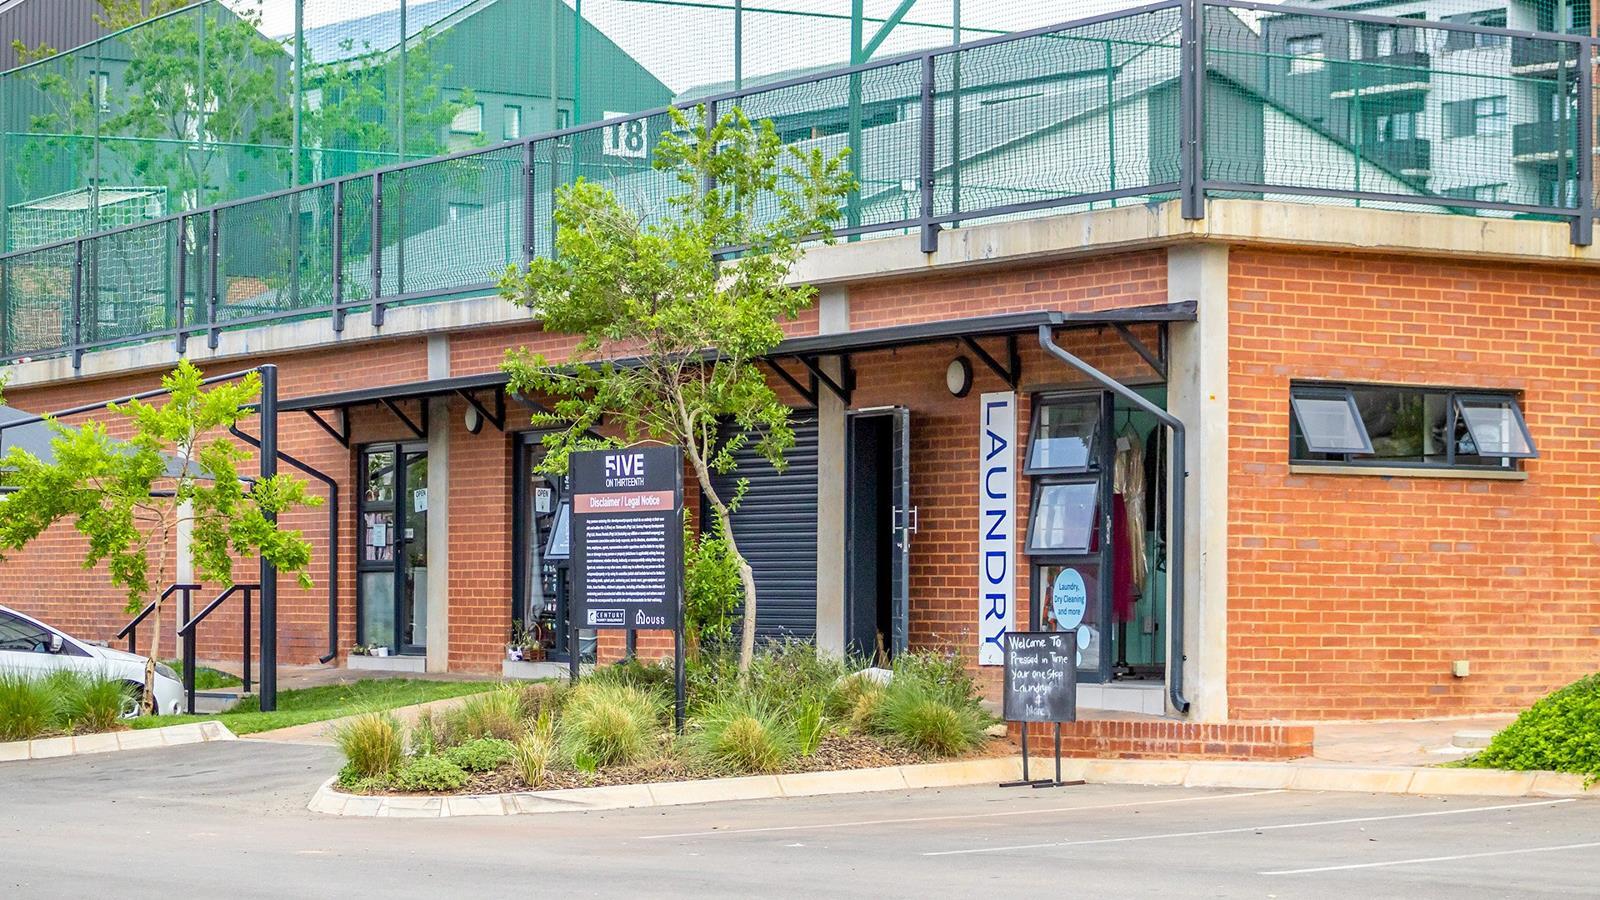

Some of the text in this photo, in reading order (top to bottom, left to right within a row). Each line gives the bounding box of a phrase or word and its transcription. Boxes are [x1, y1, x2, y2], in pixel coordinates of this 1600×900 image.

[612, 120, 643, 150] 18
[606, 477, 645, 487] ON THIRTEENTH
[416, 490, 426, 498] OPEN
[537, 490, 548, 499] OPEN
[590, 497, 620, 507] Disclaimer
[624, 496, 640, 508] Legal
[641, 495, 660, 506] Notice
[985, 401, 1008, 653] LAUNDRY
[1054, 594, 1084, 604] Dry Cleaning
[1058, 607, 1067, 615] and
[1049, 635, 1062, 647] To
[1010, 651, 1039, 665] Pressed
[1049, 651, 1068, 664] Time
[1032, 669, 1045, 679] one
